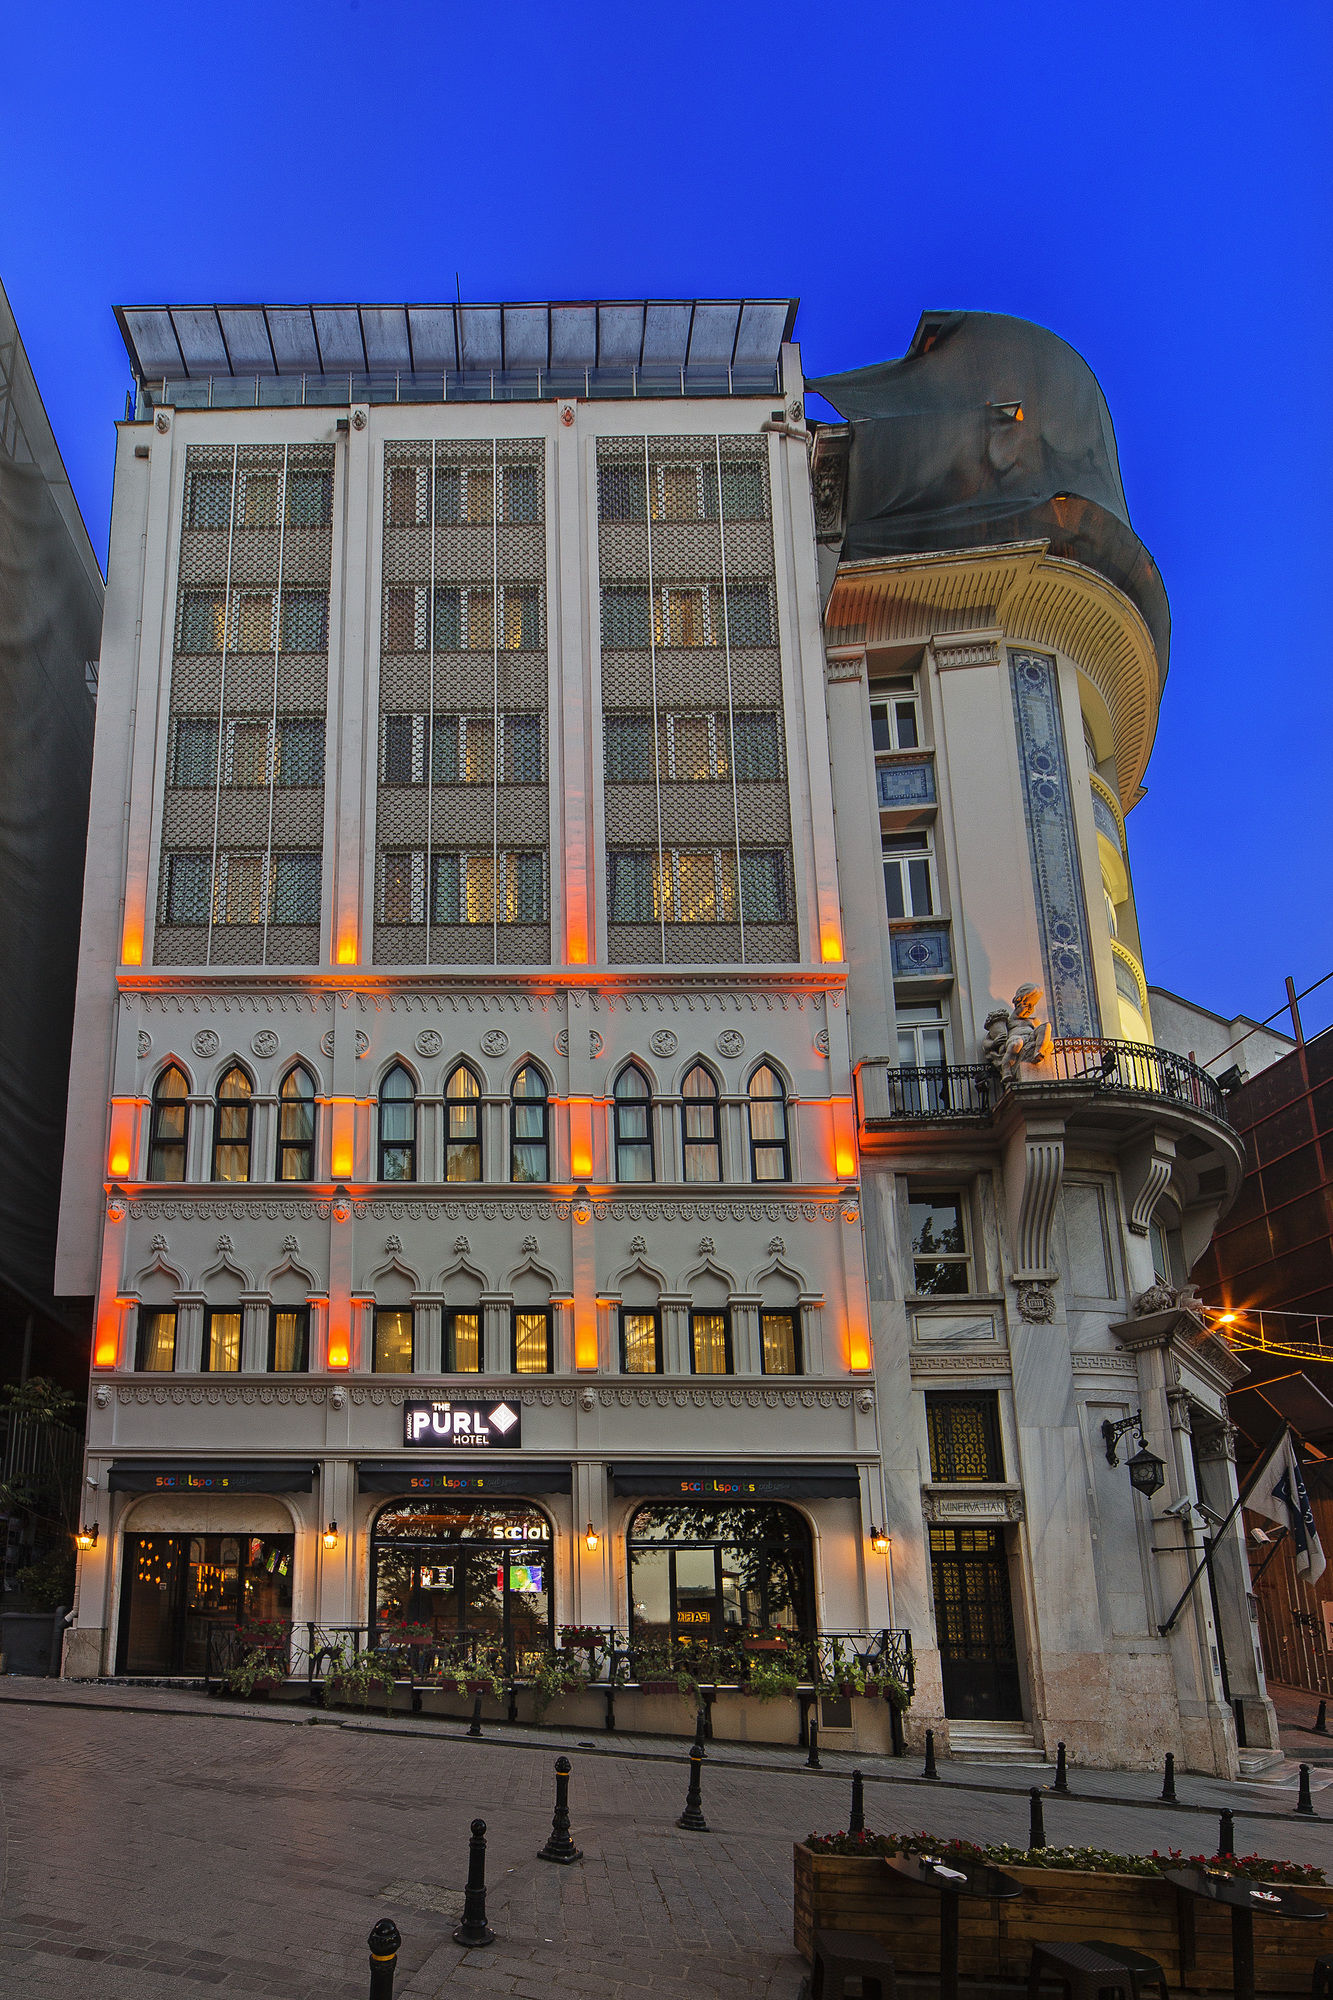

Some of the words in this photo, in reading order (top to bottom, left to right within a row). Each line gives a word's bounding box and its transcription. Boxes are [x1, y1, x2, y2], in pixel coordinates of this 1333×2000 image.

[432, 1402, 451, 1412] THE
[413, 1411, 490, 1439] PURL
[453, 1435, 490, 1445] HOTEL
[493, 1523, 550, 1540] social
